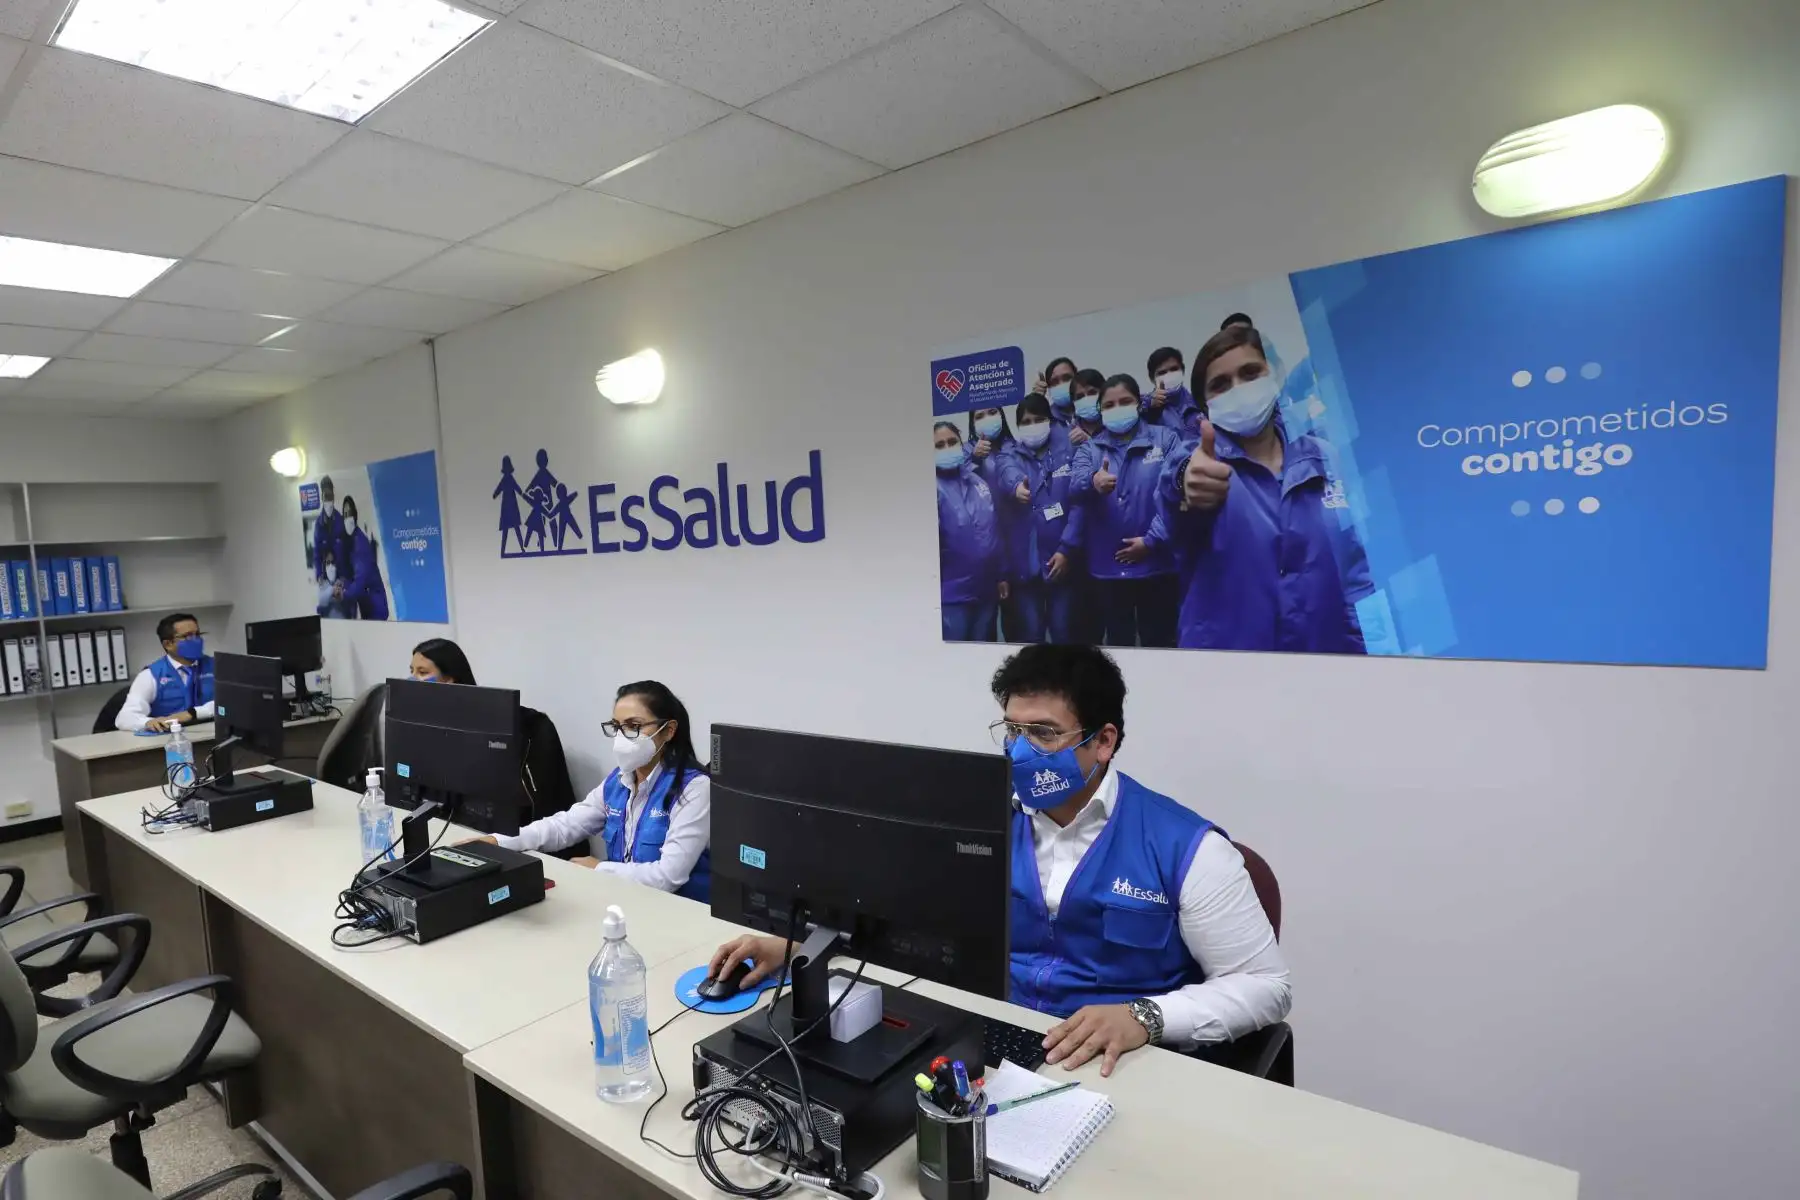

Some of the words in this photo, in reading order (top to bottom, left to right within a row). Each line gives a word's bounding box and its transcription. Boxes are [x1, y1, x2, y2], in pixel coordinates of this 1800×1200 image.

[969, 362, 997, 373] Oficina
[999, 360, 1009, 368] de
[969, 371, 1005, 382] Atención
[969, 378, 1014, 391] Asegurado
[1417, 400, 1728, 448] Comprometidos
[1461, 438, 1633, 476] contigo
[588, 449, 826, 554] EsSalud
[401, 537, 427, 551] contigo
[1031, 779, 1070, 797] EsSalud
[956, 841, 993, 856] ThinkVision
[1134, 887, 1169, 905] EsSalu
